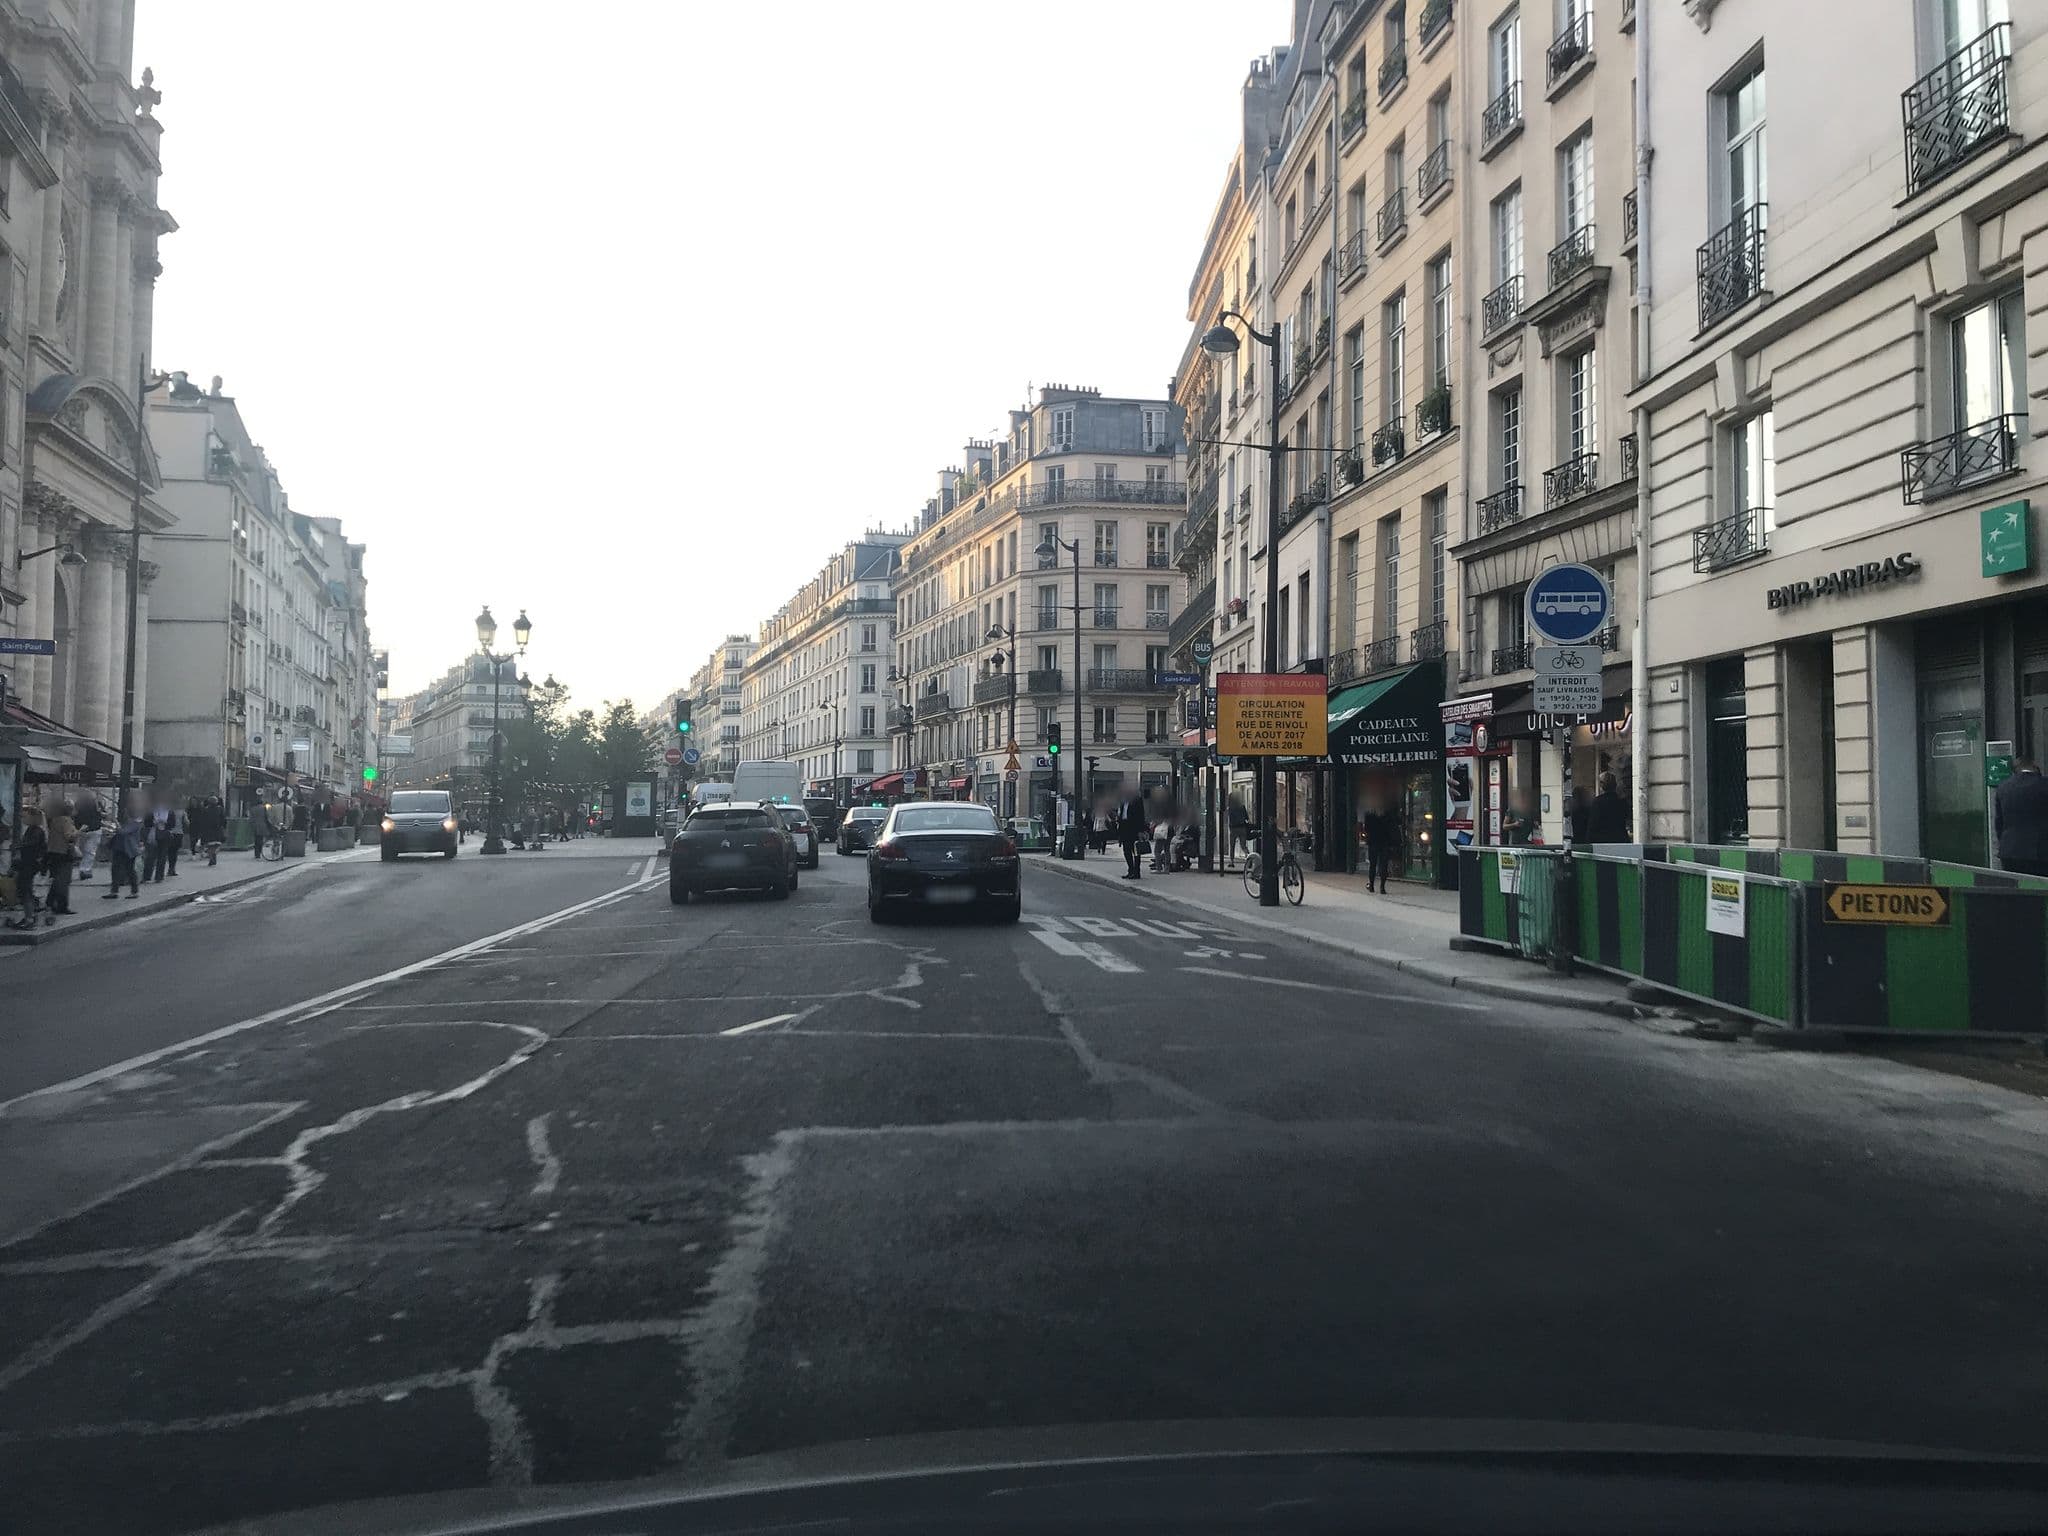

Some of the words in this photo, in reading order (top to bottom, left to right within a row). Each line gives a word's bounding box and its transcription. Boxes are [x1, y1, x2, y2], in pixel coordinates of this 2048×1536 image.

[1767, 581, 1810, 610] BNP
[1813, 552, 1914, 598] PARIBAS
[2, 642, 43, 651] Saint-Paul
[1195, 643, 1211, 652] BUS
[1223, 680, 1276, 688] ATTENTION
[1280, 680, 1321, 688] TRAVAUX
[1548, 677, 1588, 685] INTERDIT
[1556, 686, 1600, 694] LIVRAISONS
[1238, 700, 1305, 709] CIRCULATION
[1241, 710, 1303, 719] RESTREINTE
[1235, 721, 1257, 729] RUE
[1259, 721, 1273, 729] DE
[1275, 721, 1308, 729] RIVOLI
[1358, 718, 1418, 730] CADEAUX
[1238, 731, 1253, 739] DE
[1254, 731, 1282, 739] AOUT
[1284, 731, 1305, 739] 2017
[1350, 732, 1431, 745] PORCELAINE
[1250, 741, 1280, 749] MARS
[1281, 741, 1303, 750] 2018
[1341, 750, 1438, 764] VAISSELLERIE
[1841, 893, 1935, 915] PIETONS
[1061, 915, 1258, 943] BUS
